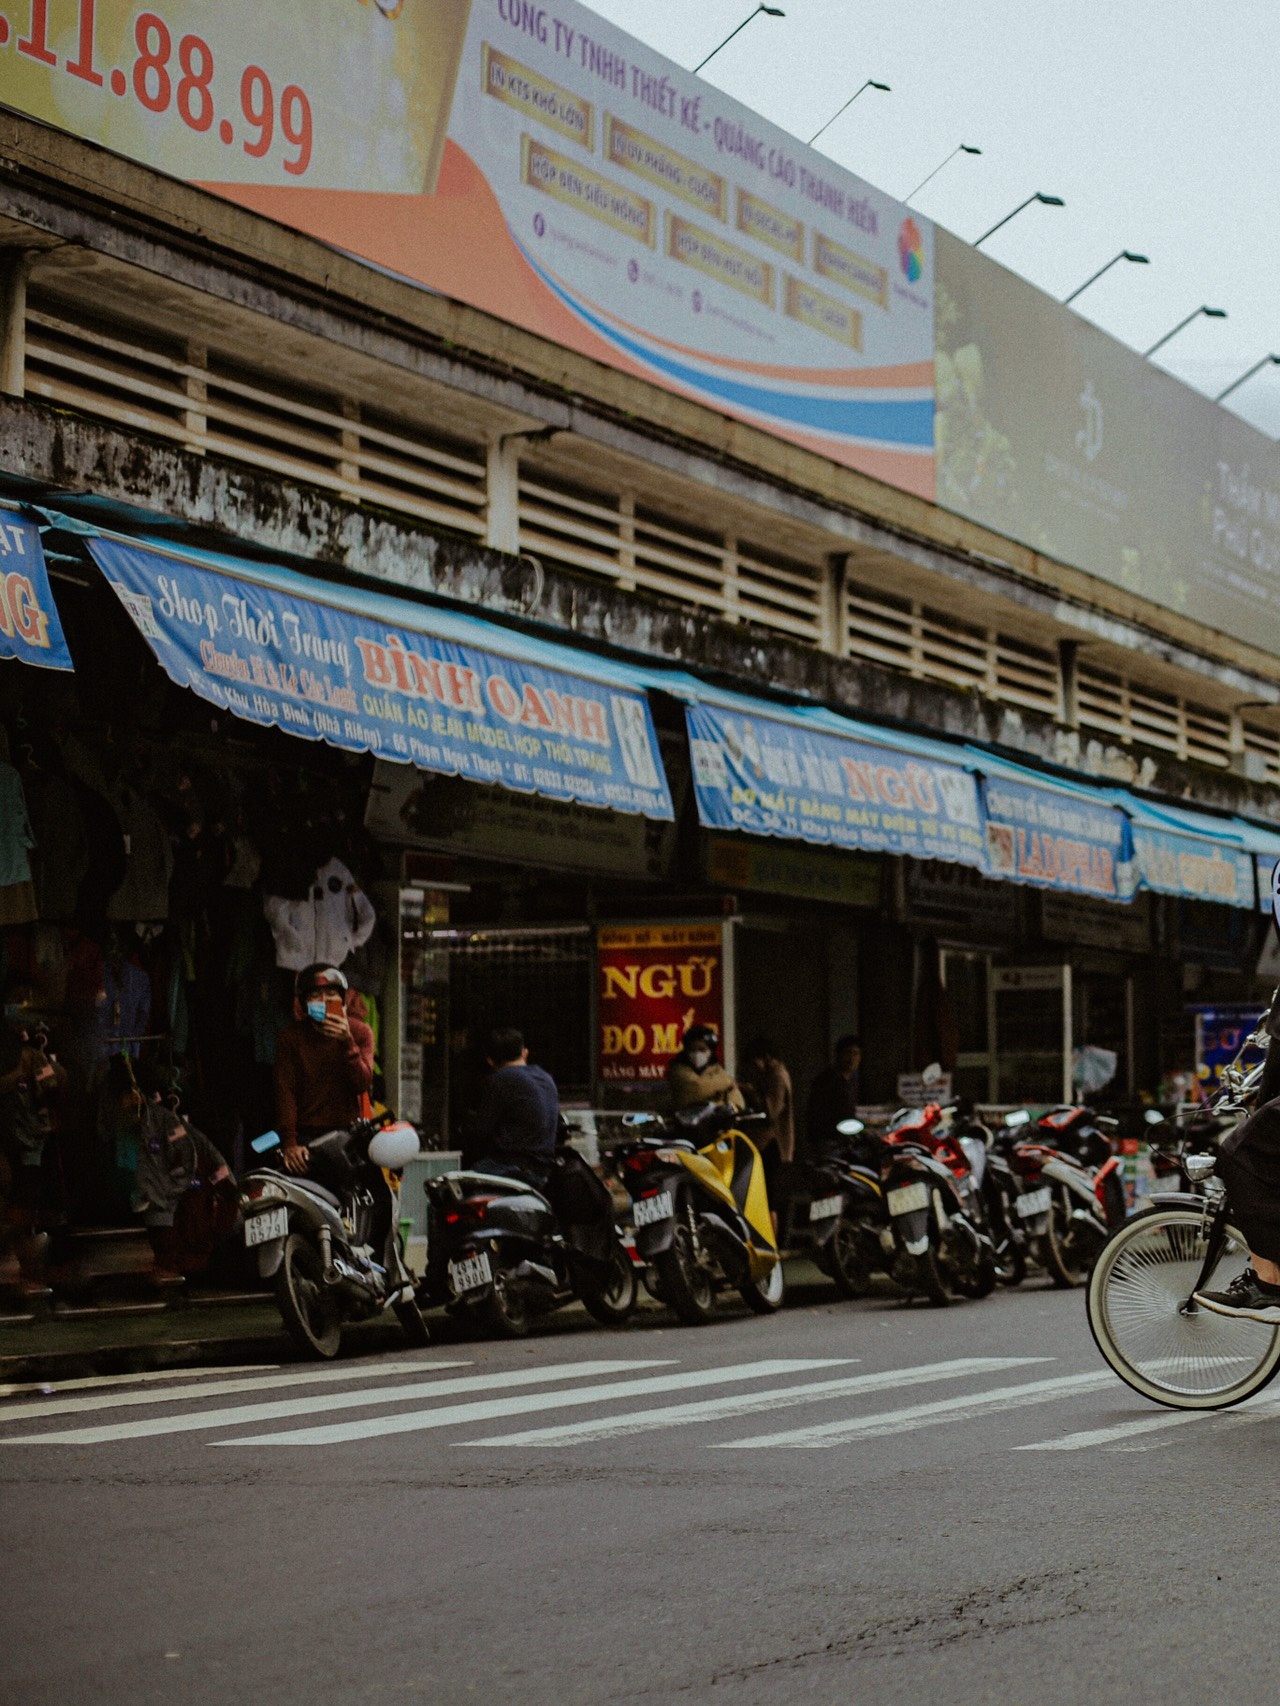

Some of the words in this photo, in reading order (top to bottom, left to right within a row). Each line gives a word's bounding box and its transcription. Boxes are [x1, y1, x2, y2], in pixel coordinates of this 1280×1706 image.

[553, 18, 575, 58] TY
[579, 34, 627, 90] TNHH
[157, 574, 223, 639] Shop
[221, 592, 283, 650] Thời
[282, 609, 352, 689] Trang
[224, 685, 250, 709] Khu
[354, 632, 488, 718] BÌNH
[486, 673, 613, 749] OANH
[407, 700, 430, 731] ÁO
[430, 711, 466, 741] JEAN
[602, 955, 718, 999] NGỮ
[602, 1023, 646, 1055] ĐO
